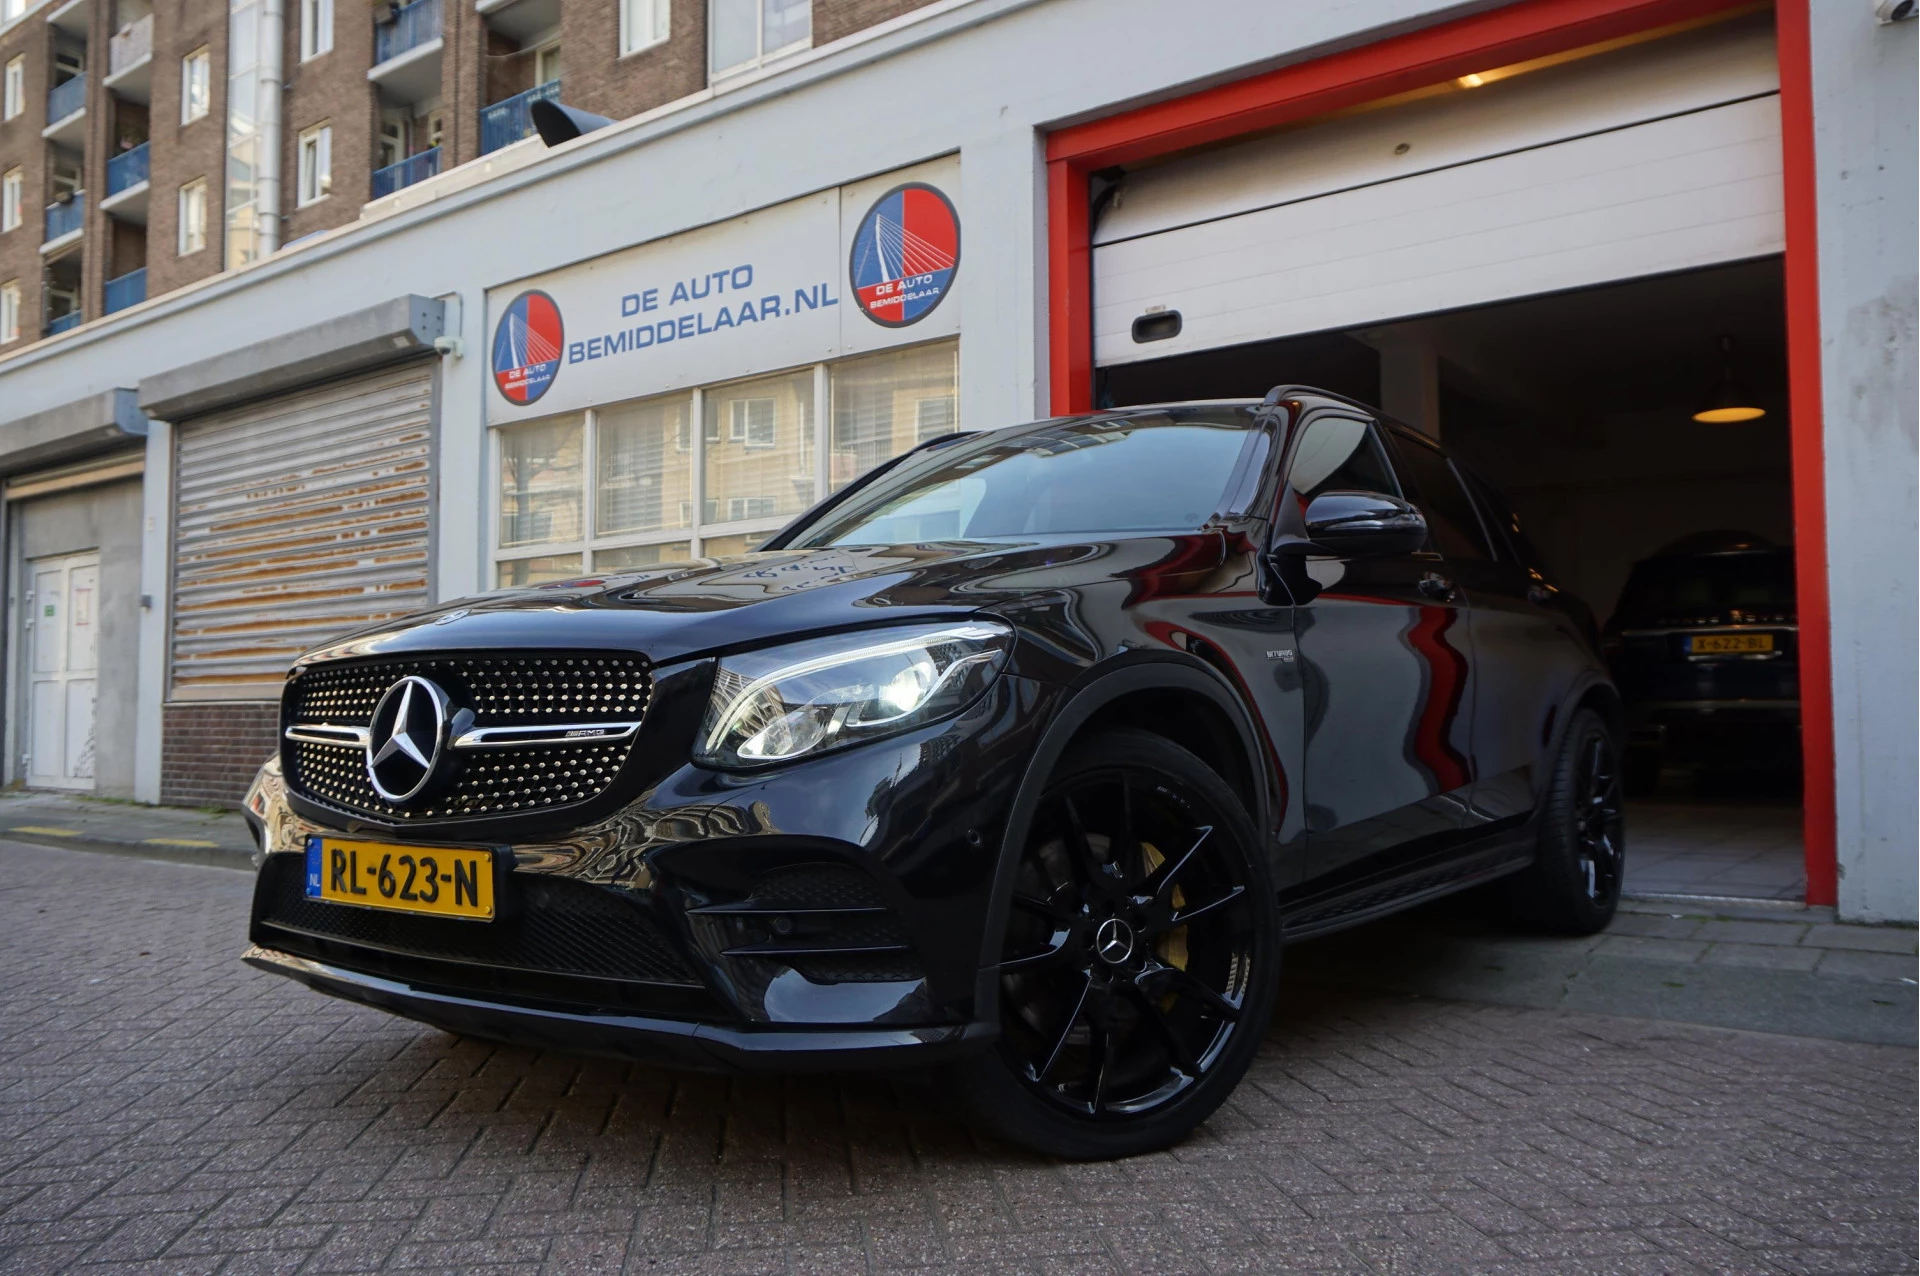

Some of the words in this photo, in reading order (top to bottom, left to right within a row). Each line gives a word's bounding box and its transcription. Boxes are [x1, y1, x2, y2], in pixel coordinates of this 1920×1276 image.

[621, 288, 658, 318] DE
[669, 263, 753, 307] AUTO
[875, 283, 893, 296] DE
[896, 274, 933, 292] AUTO
[869, 287, 940, 309] BEMIDDELAAR
[569, 282, 839, 365] BEMIDDELAAR.NL
[508, 369, 521, 380] DE
[522, 363, 546, 377] AUTO
[577, 729, 605, 737] AMG
[309, 873, 321, 887] NL
[331, 848, 478, 908] RL-623-N
